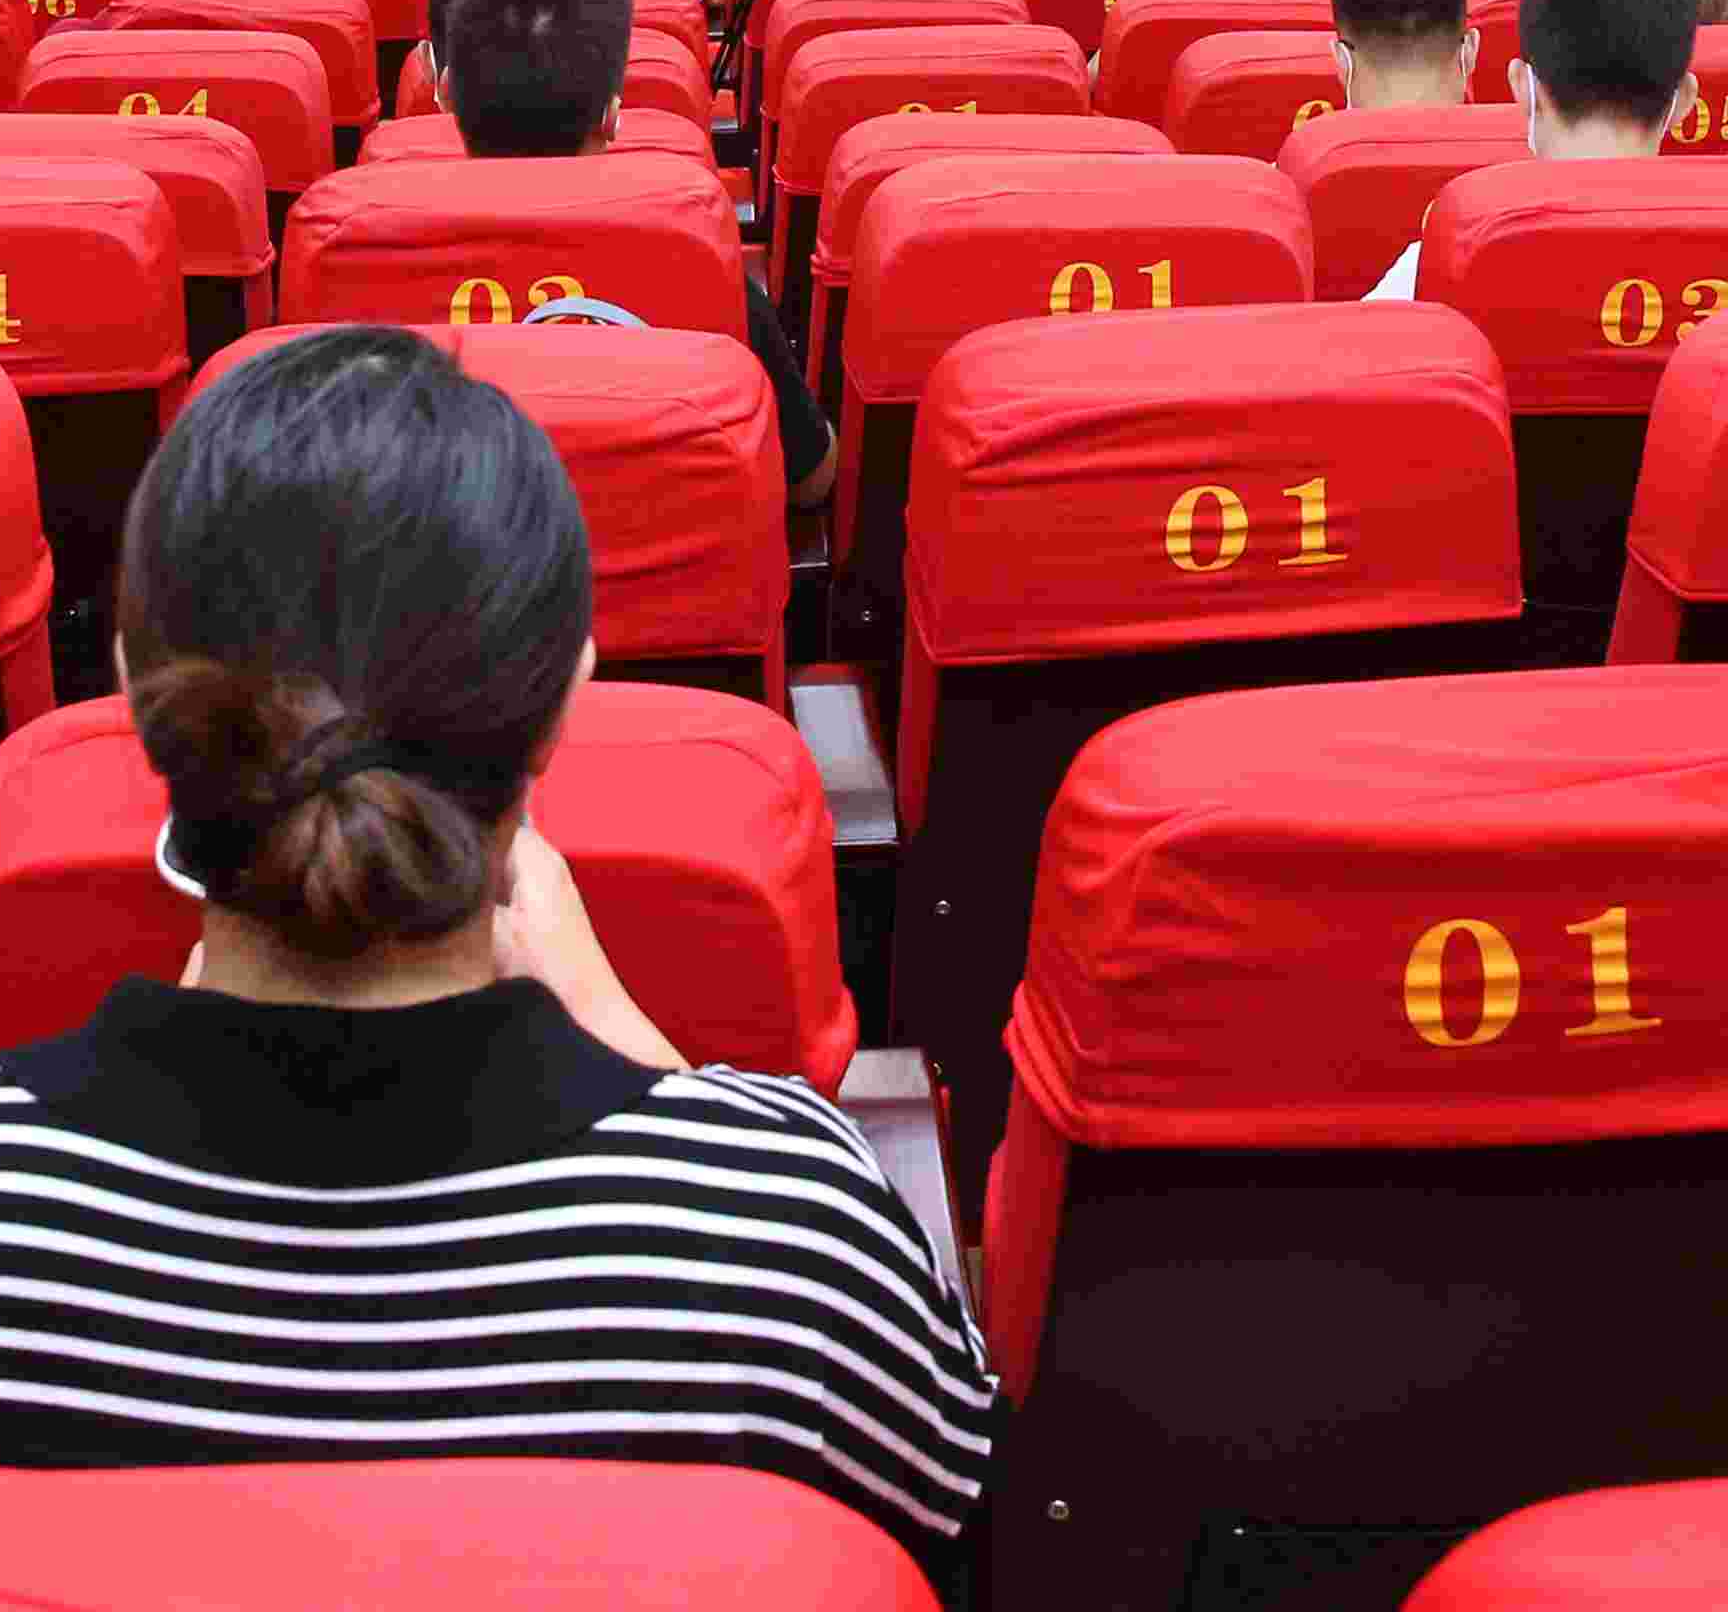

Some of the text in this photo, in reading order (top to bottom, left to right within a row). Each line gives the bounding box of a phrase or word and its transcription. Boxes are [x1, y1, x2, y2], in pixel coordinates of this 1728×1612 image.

[1049, 259, 1173, 316] 01
[1165, 475, 1349, 572] 01
[1403, 905, 1664, 1048] 01
